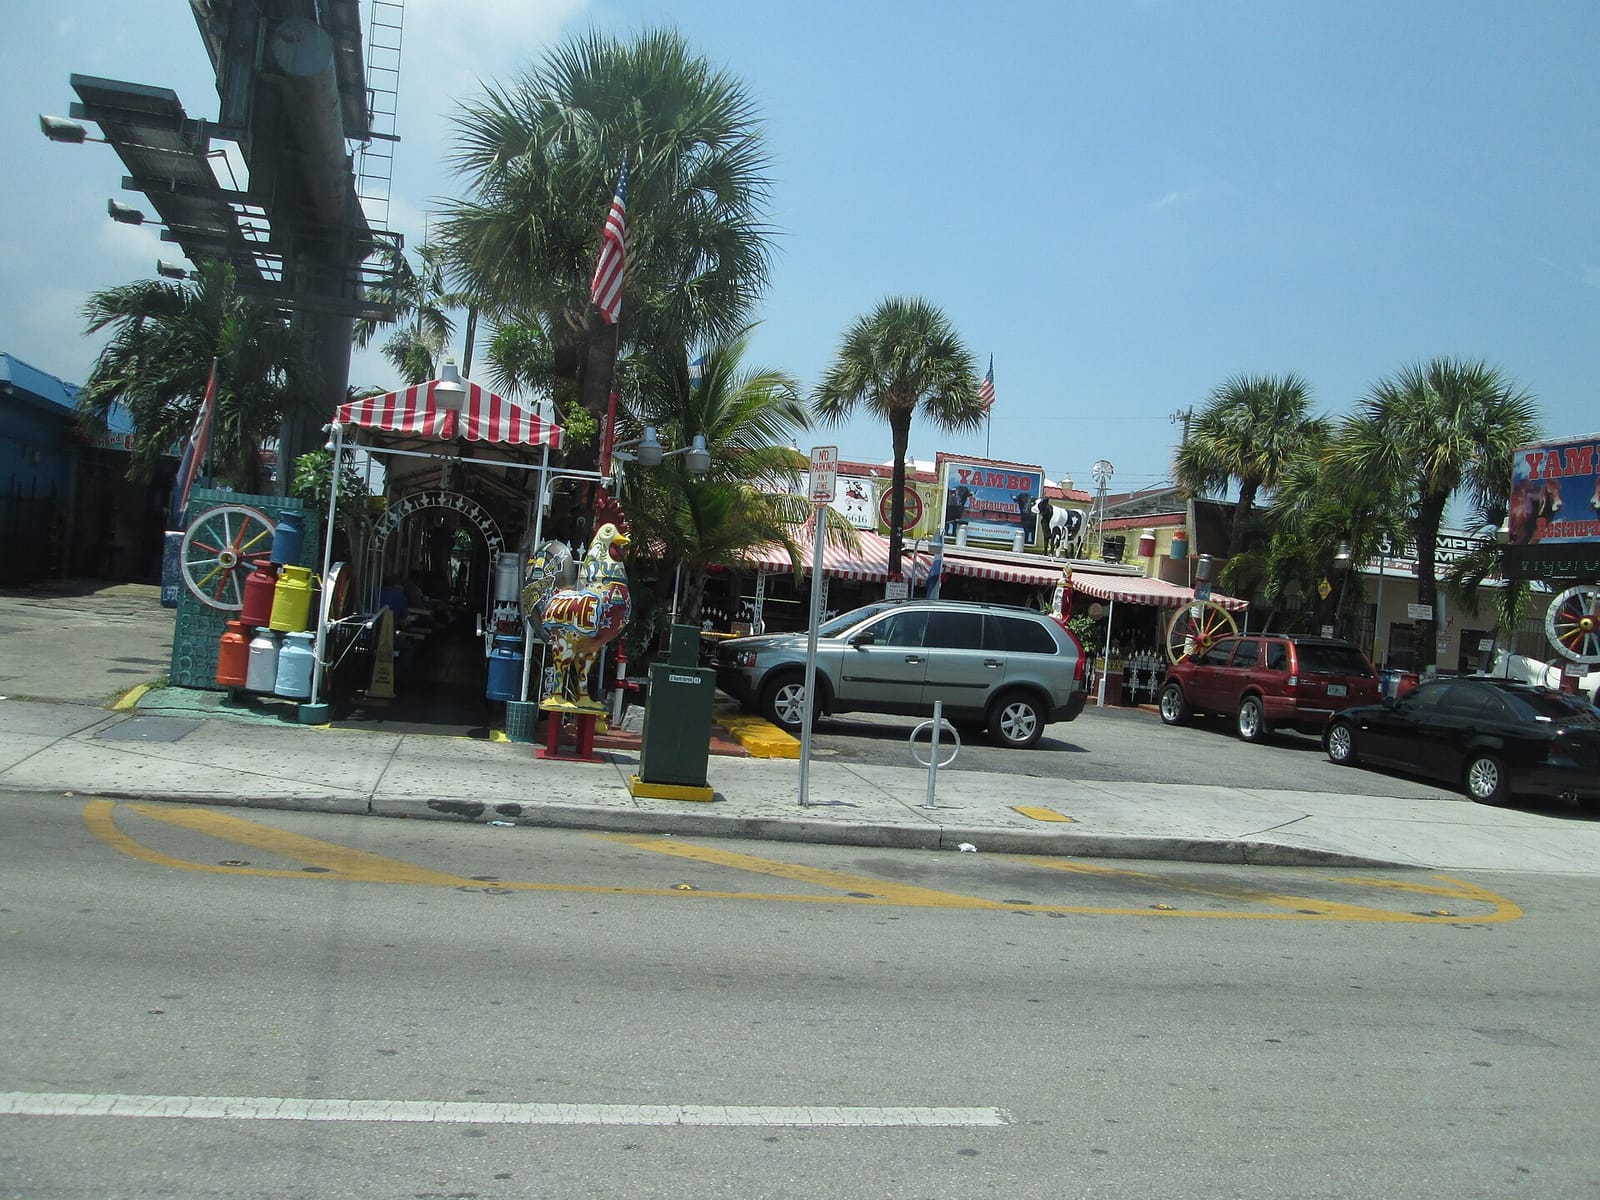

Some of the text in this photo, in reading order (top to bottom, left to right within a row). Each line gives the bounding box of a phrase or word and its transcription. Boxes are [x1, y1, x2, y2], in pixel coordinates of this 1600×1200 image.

[819, 450, 830, 461] NO
[1525, 445, 1600, 480] YAM
[813, 461, 834, 472] PARKING
[958, 469, 1032, 492] YAMBO
[968, 496, 1019, 513] Restaurant
